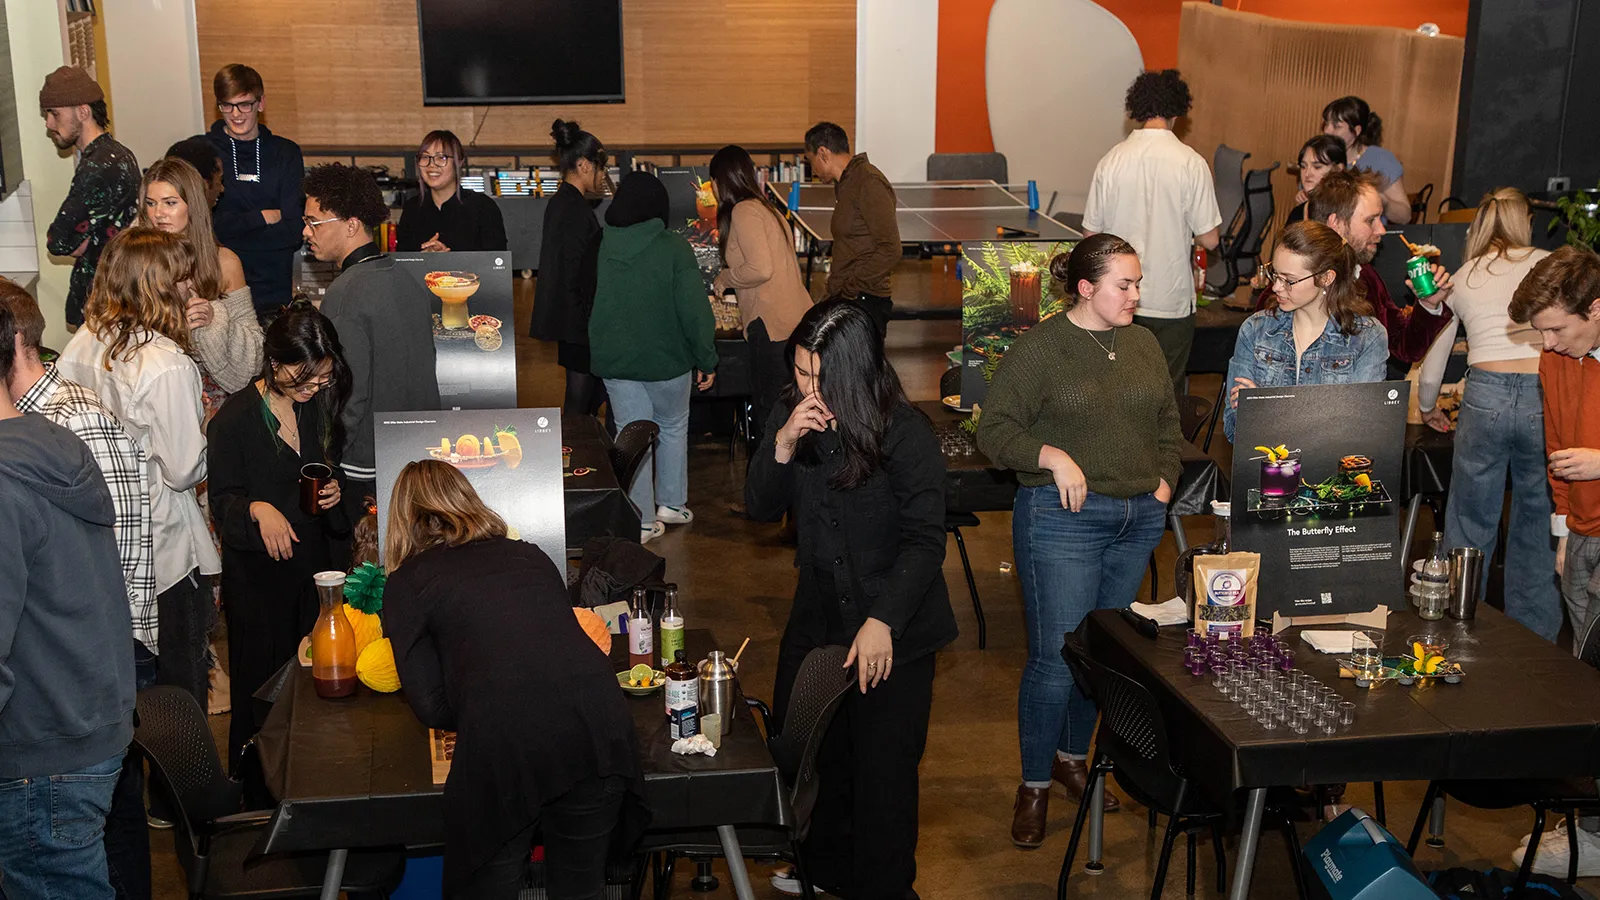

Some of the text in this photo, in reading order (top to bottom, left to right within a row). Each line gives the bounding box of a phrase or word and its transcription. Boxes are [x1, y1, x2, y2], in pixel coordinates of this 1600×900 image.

[1286, 525, 1356, 536] The Butterfly Effect
[1320, 848, 1343, 882] Playmate
